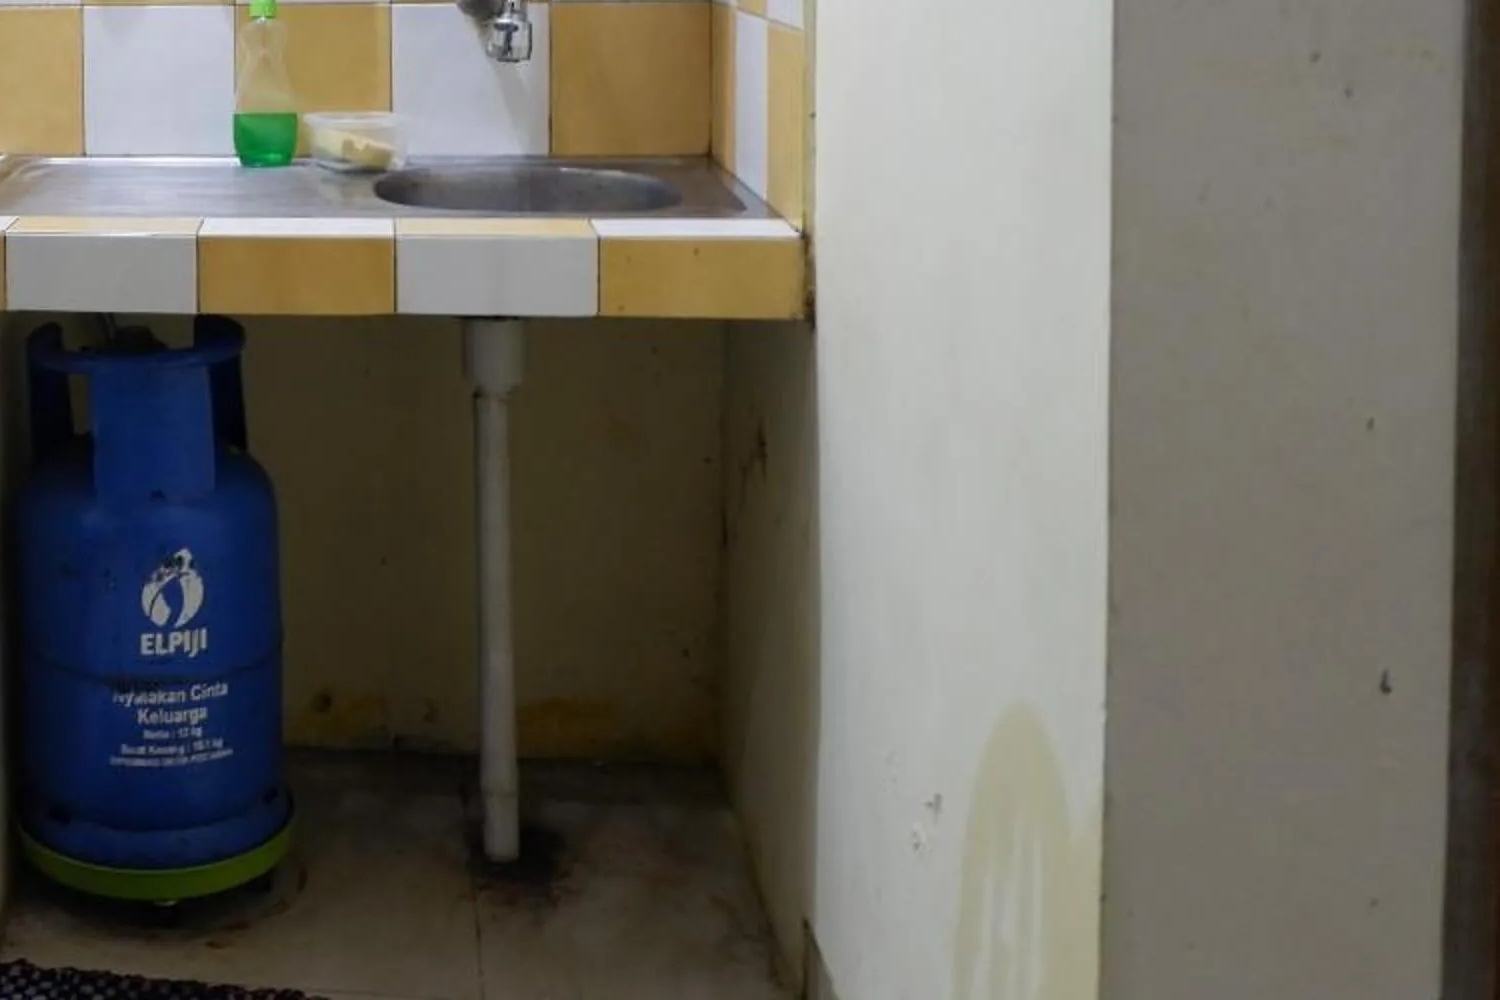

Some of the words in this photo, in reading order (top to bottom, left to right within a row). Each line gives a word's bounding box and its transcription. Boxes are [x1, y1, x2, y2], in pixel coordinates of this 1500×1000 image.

[140, 628, 207, 657] ELPIJI
[191, 681, 229, 701] Cinta
[137, 707, 208, 725] Keluarga
